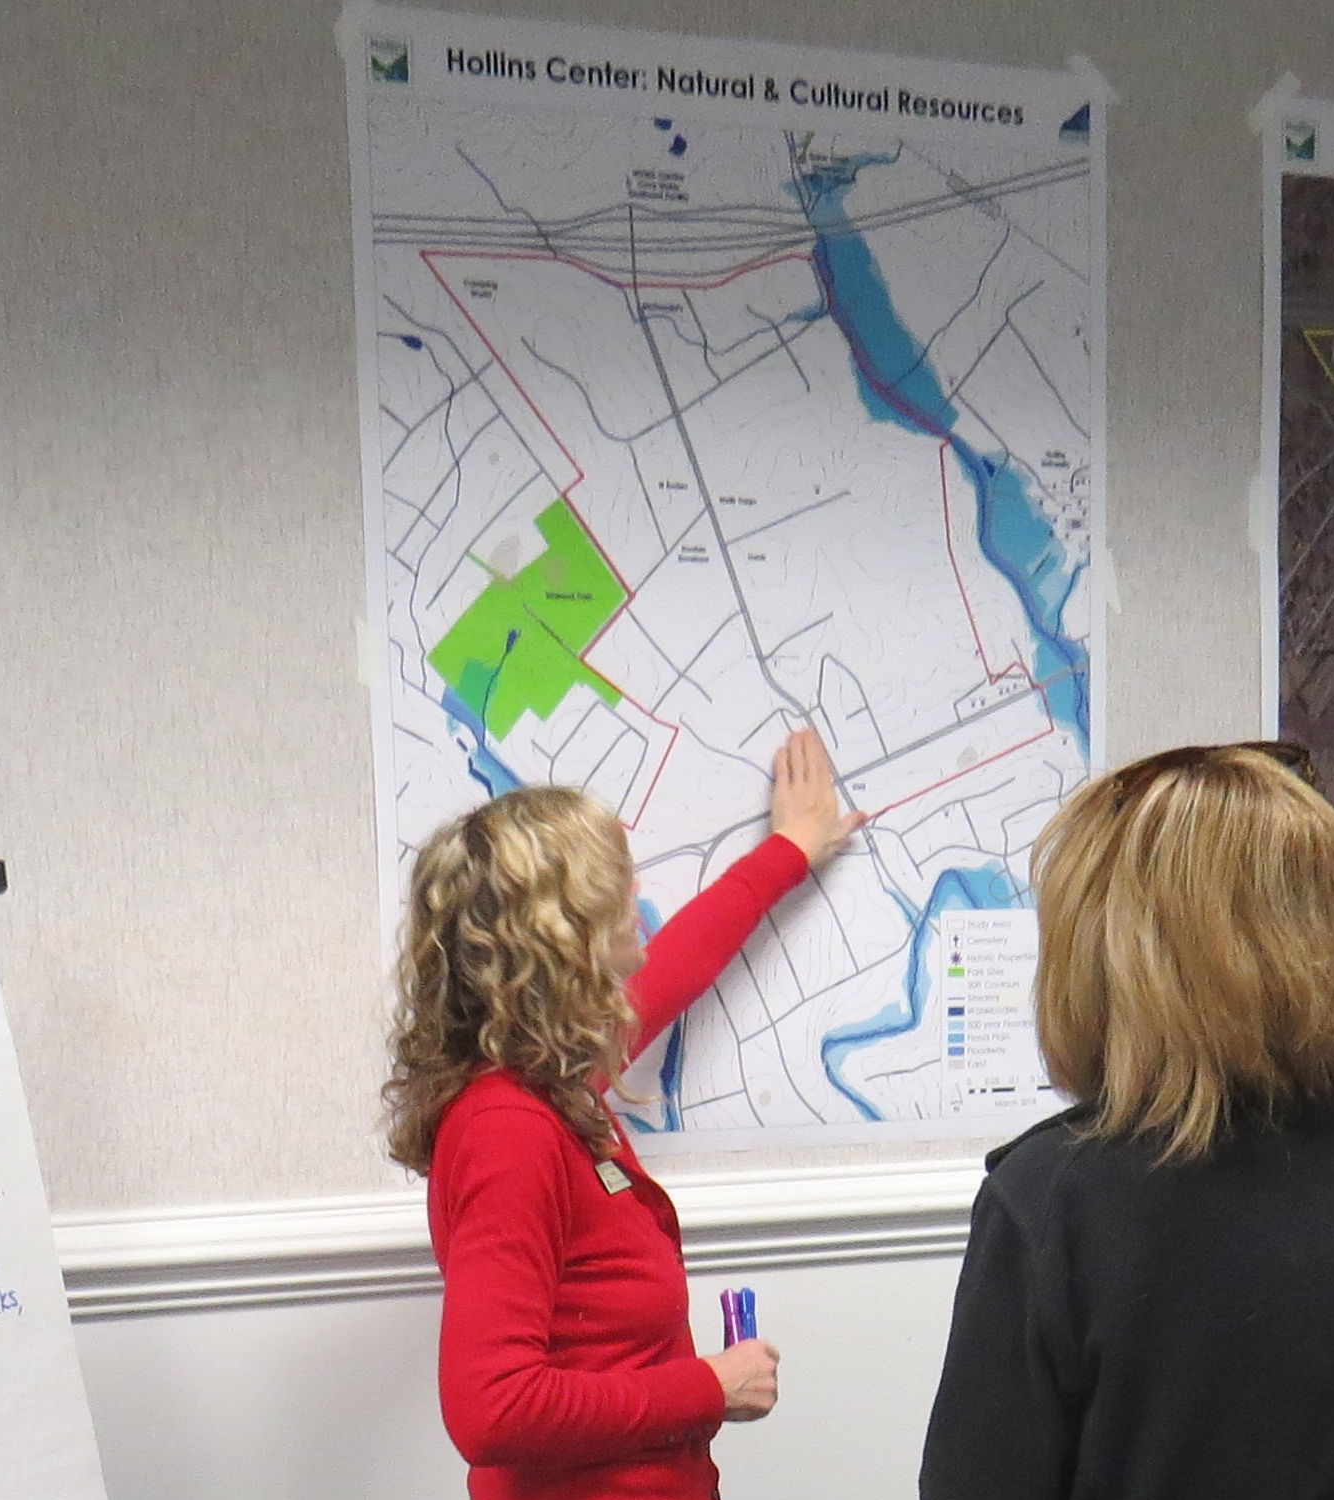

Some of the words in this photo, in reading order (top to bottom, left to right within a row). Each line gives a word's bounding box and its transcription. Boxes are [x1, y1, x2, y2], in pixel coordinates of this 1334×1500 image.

[446, 47, 537, 81] Hollins
[546, 55, 647, 91] Center:
[657, 65, 755, 100] Natural
[764, 77, 779, 102] &
[790, 79, 889, 113] Cultural
[898, 88, 1024, 126] Resources
